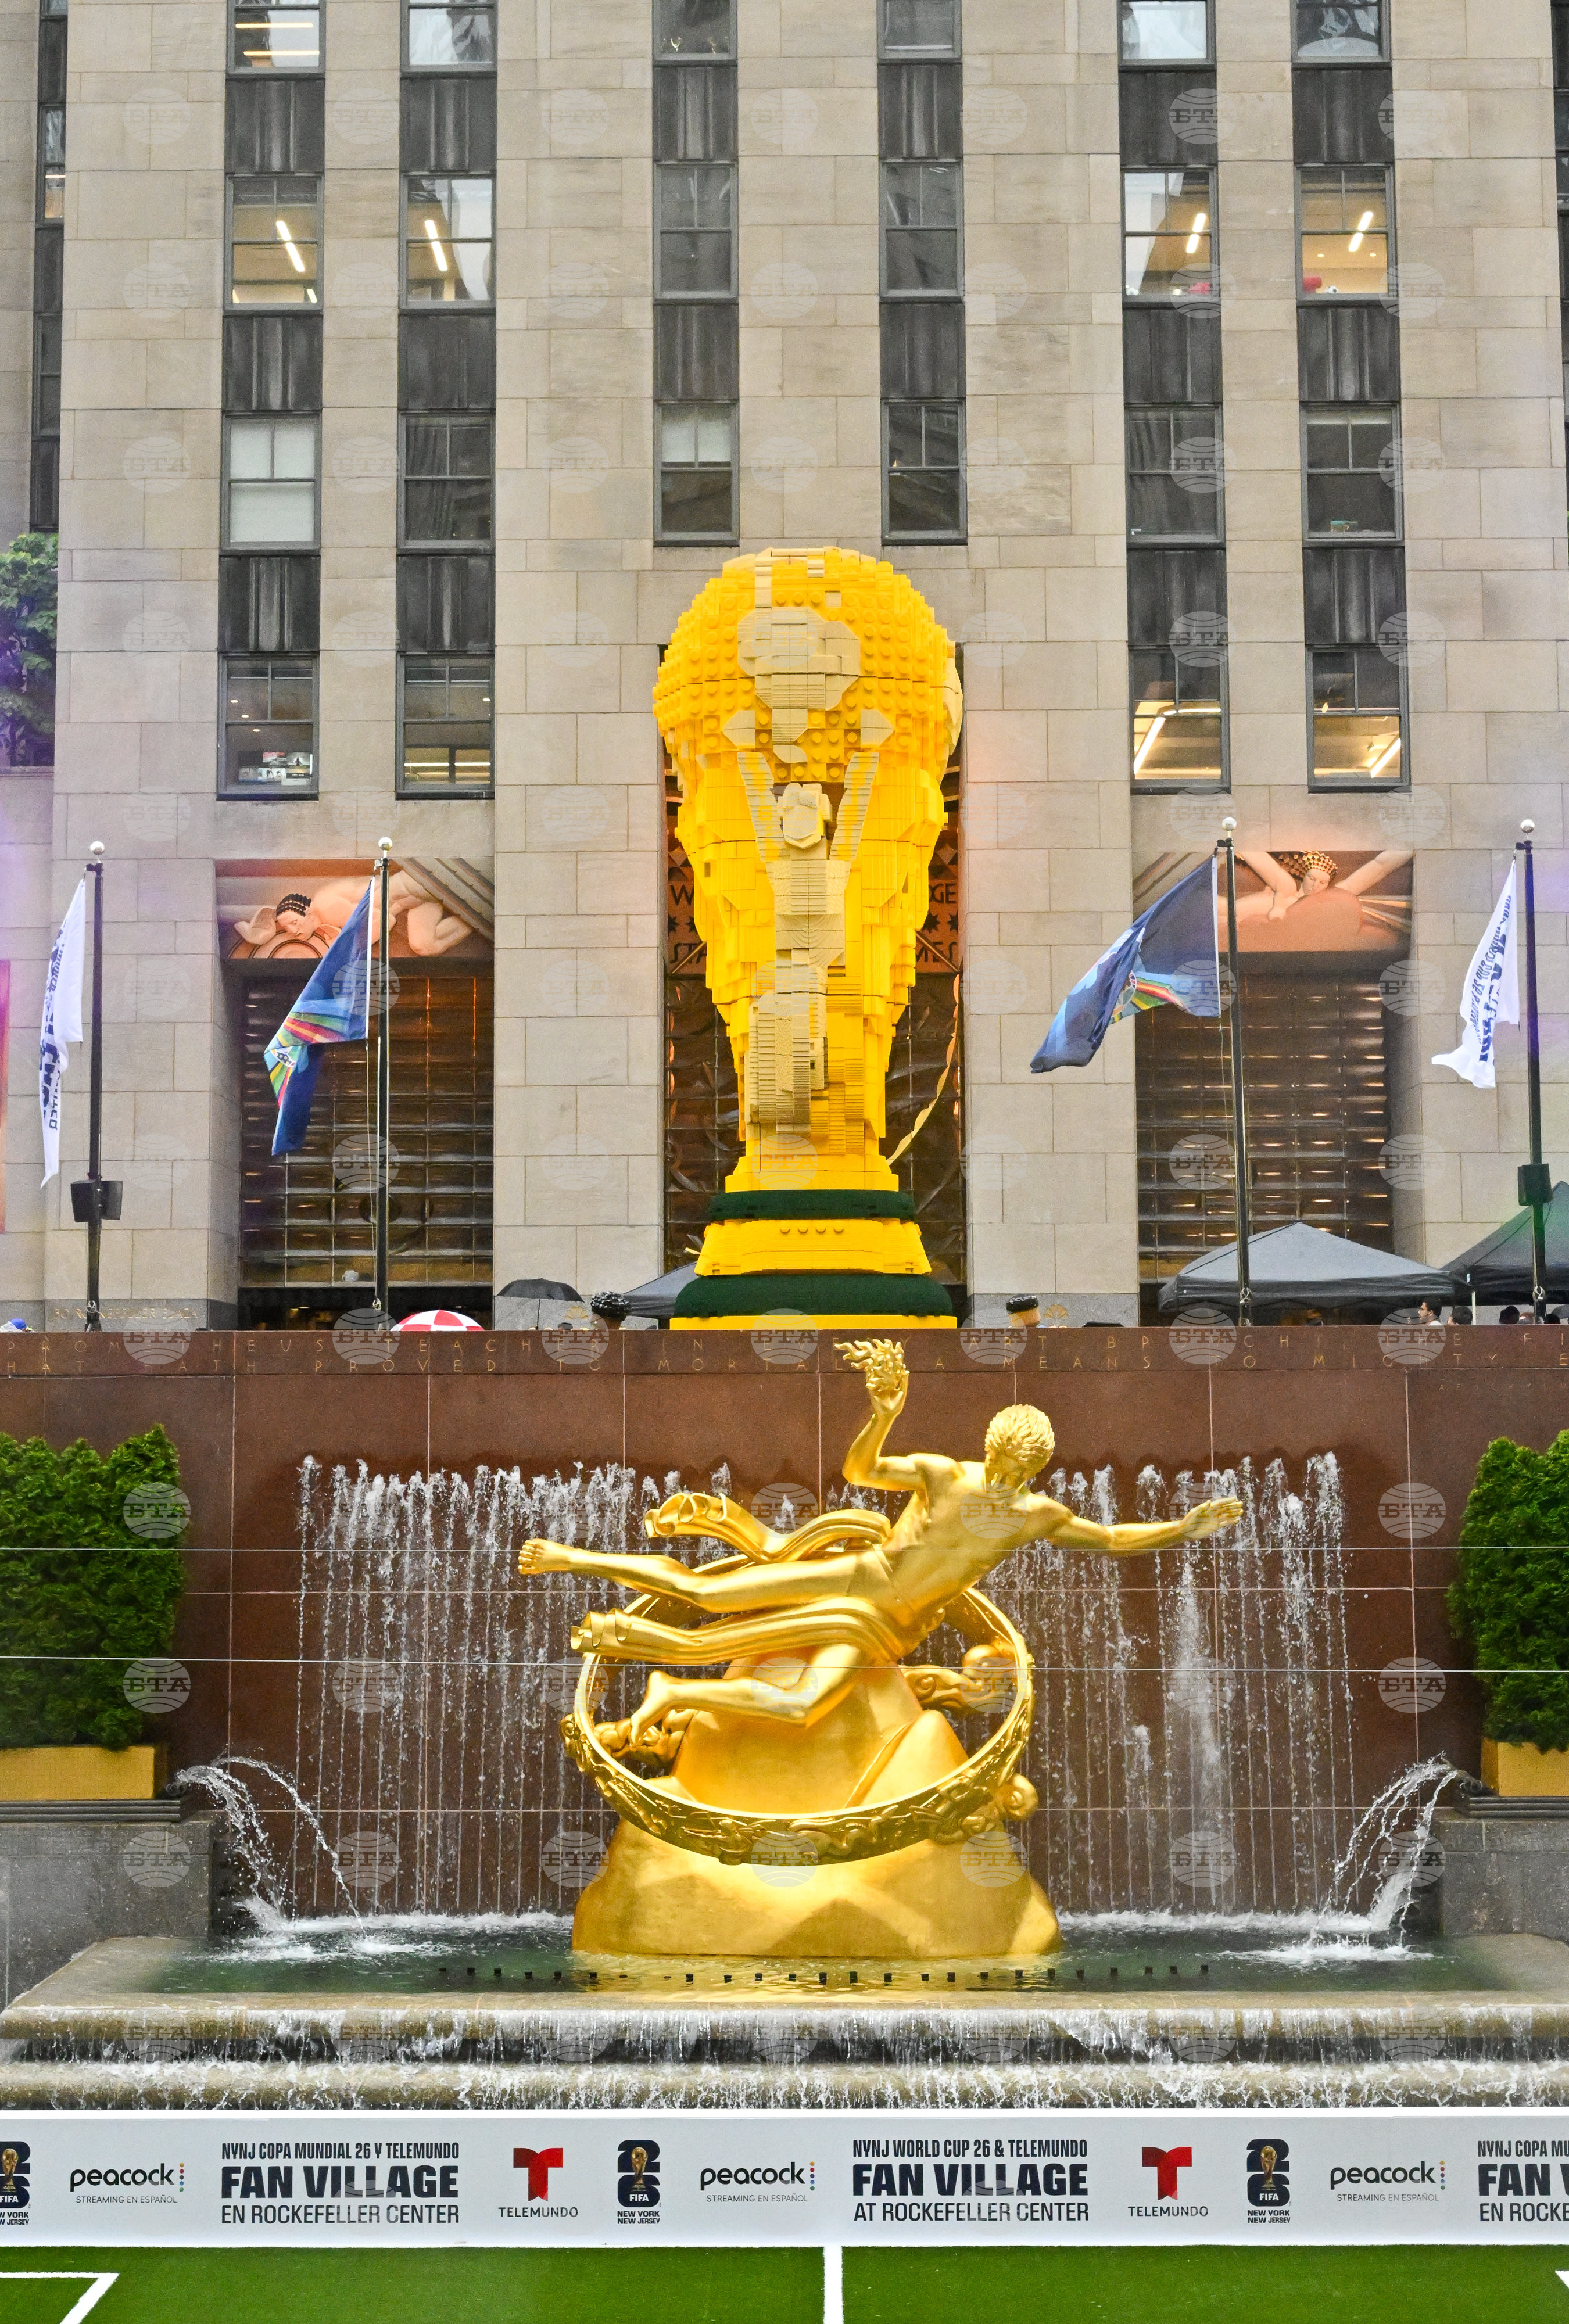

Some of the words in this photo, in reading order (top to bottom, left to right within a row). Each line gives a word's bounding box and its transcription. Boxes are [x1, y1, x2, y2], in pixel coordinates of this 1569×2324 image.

[315, 1360, 495, 1372] PROVED
[556, 1358, 601, 1372] TO
[222, 2143, 255, 2160] NYNJ
[259, 2143, 291, 2160] COPA
[295, 2143, 351, 2160] MUNDIAL
[356, 2143, 370, 2160] 26
[375, 2143, 382, 2159] Y
[386, 2142, 458, 2159] TELEMUNDO
[854, 2140, 889, 2157] NYNJ
[893, 2140, 940, 2157] WORLD
[944, 2140, 969, 2157] CUP
[974, 2140, 990, 2157] 26
[995, 2140, 1004, 2157] &
[1008, 2139, 1087, 2157] TELEMUNDO
[1478, 2140, 1511, 2157] NYNJ
[1516, 2140, 1548, 2157] COPA
[70, 2162, 174, 2192] peacock
[222, 2166, 292, 2198] FAN
[303, 2165, 458, 2198] VILLAGE
[701, 2162, 805, 2190] peacock
[853, 2164, 923, 2196] FAN
[933, 2164, 1088, 2196] VILLAGE
[1331, 2160, 1435, 2190] peacock
[1478, 2164, 1551, 2196] FAN
[141, 2194, 178, 2203] ESPAÑOL
[772, 2193, 809, 2202] ESPAÑOL
[1402, 2193, 1439, 2201] ESPAÑOL
[222, 2205, 245, 2223] EN
[252, 2205, 380, 2223] ROCKEFELLER
[387, 2204, 458, 2223] CENTER
[499, 2207, 578, 2217] TELEMUNDO
[854, 2203, 876, 2221] AT
[883, 2203, 1010, 2221] ROCKEFELLER
[1017, 2202, 1088, 2221] CENTER
[1128, 2206, 1208, 2217] TELEMUNDO
[1480, 2203, 1503, 2221] EN
